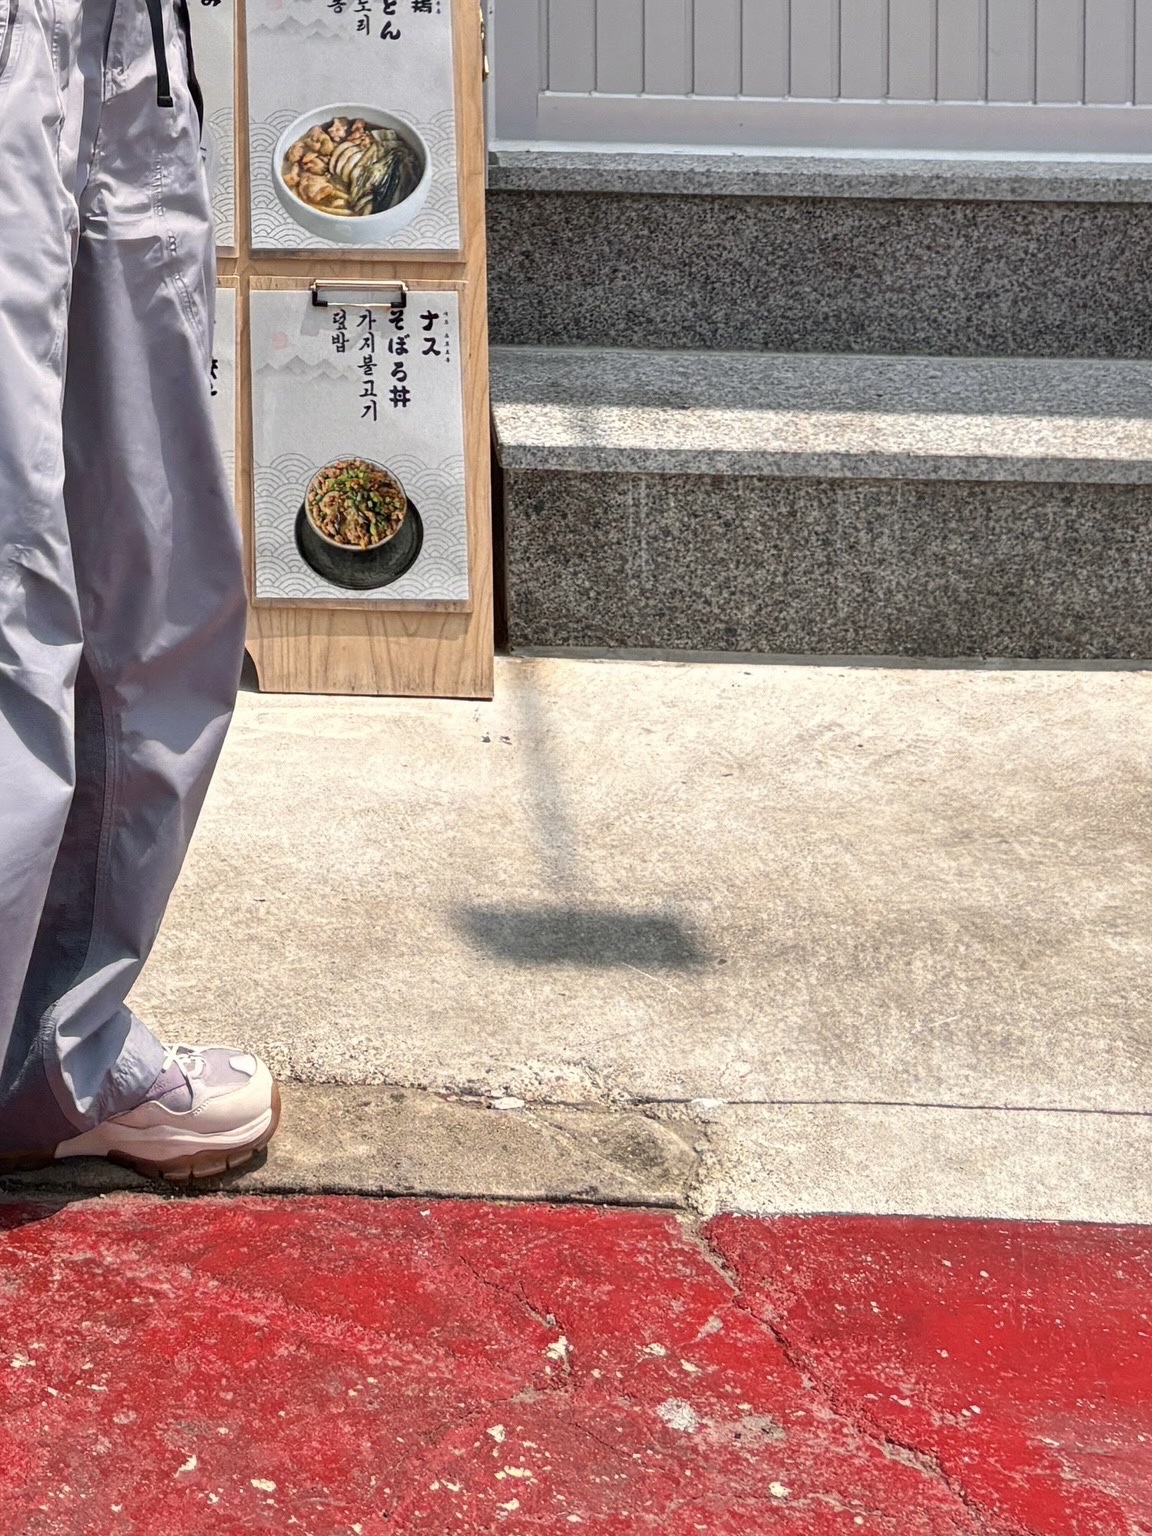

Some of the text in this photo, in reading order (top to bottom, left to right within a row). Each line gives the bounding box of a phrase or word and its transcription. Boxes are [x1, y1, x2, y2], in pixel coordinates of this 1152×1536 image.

[332, 309, 350, 353] 덮밥
[357, 309, 377, 421] 가지불고기
[388, 310, 411, 408] そぼろ丼
[420, 310, 441, 356] ナス
